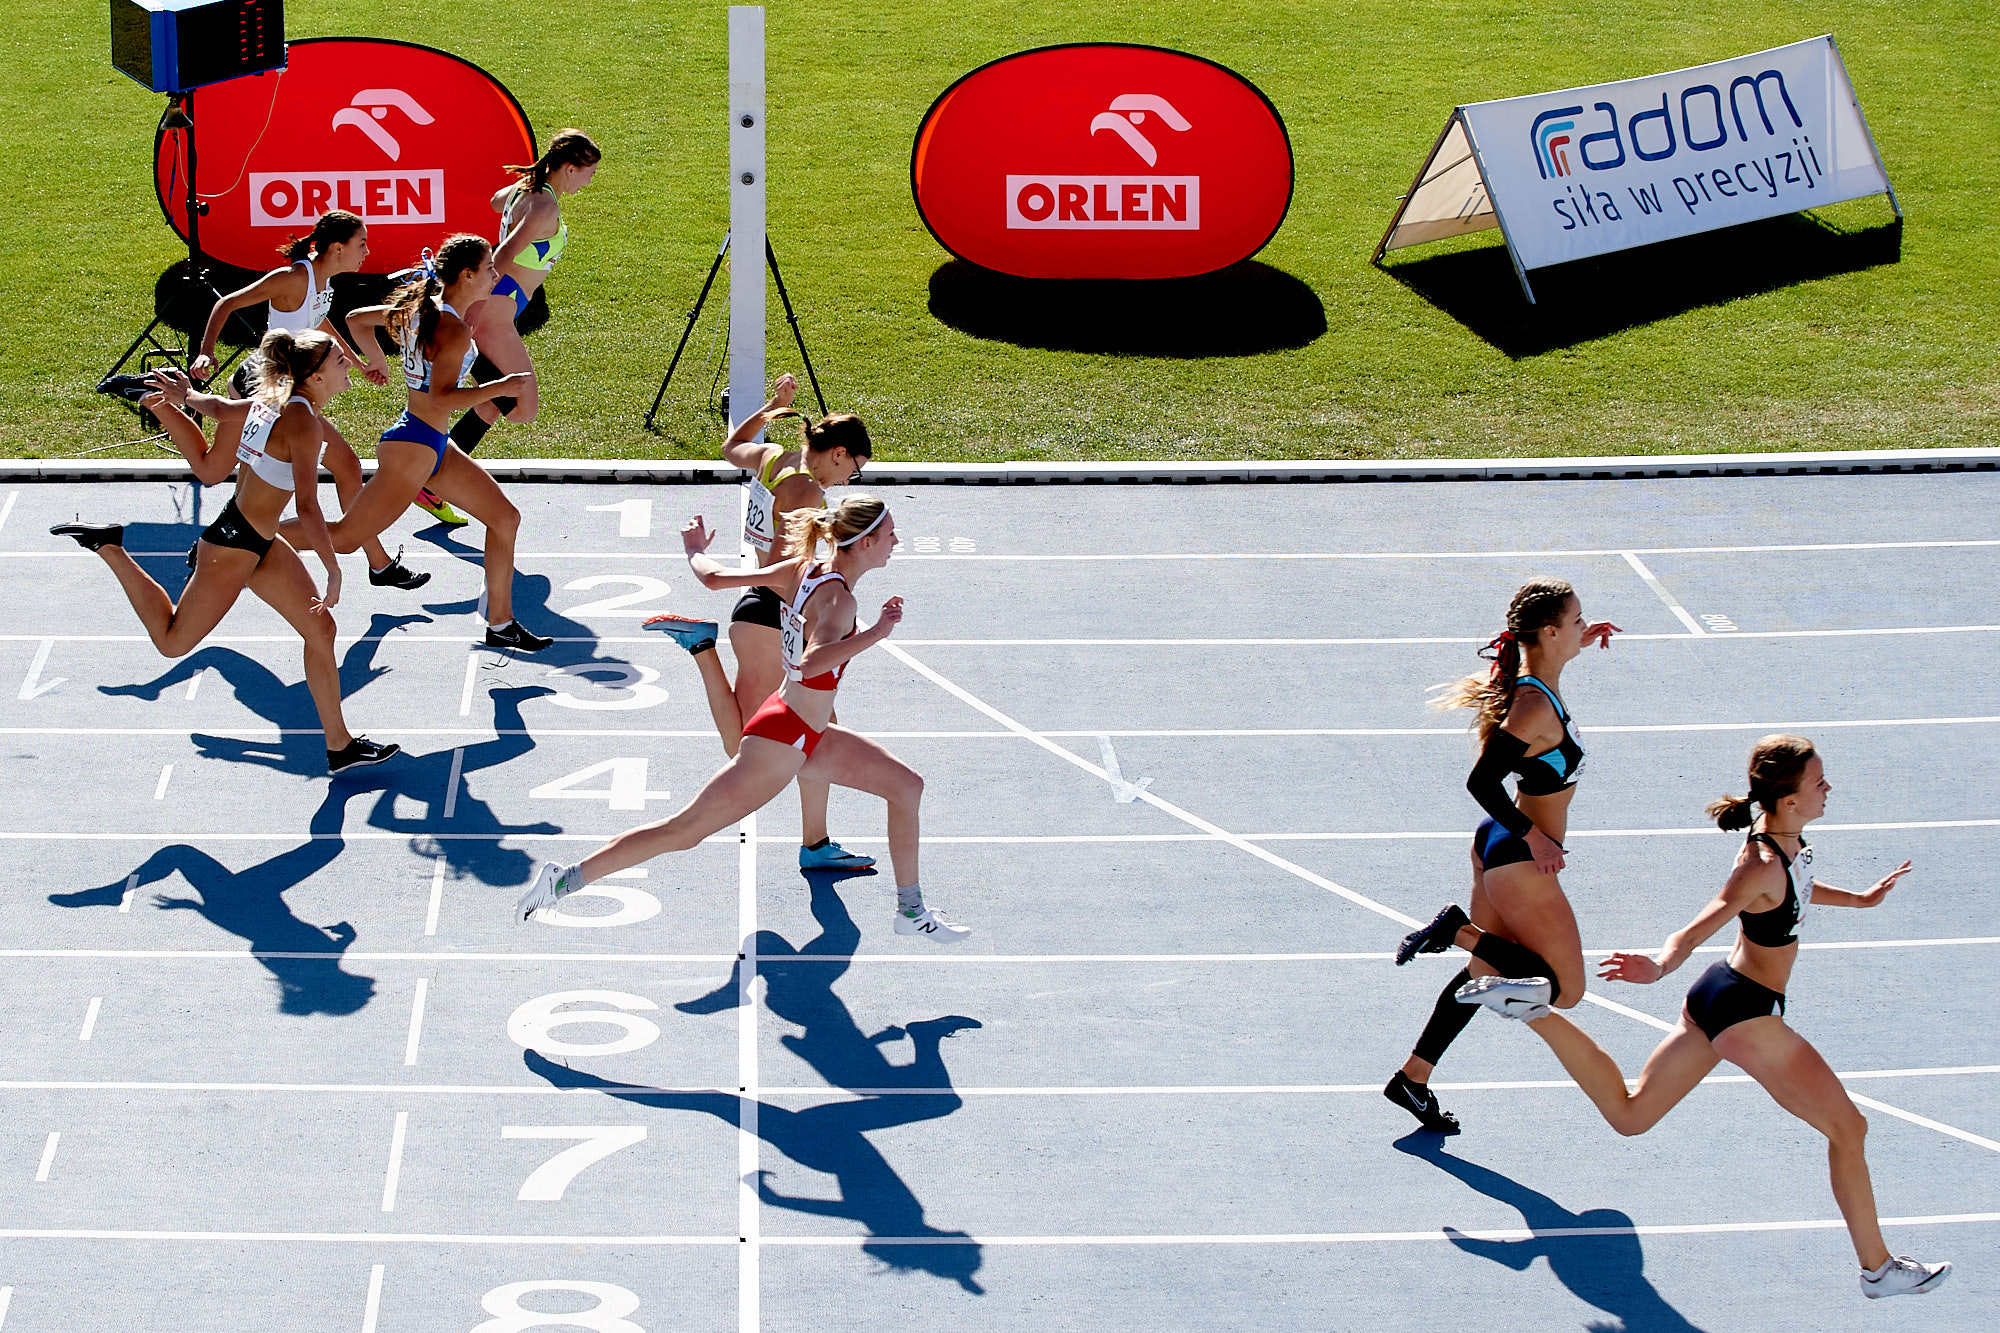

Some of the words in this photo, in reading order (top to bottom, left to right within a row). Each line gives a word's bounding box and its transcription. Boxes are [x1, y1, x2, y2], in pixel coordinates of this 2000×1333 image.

[260, 178, 432, 219] ORLEN
[1017, 183, 1187, 222] ORLEN
[1553, 183, 1623, 230] siła
[1627, 182, 1663, 216] w
[1672, 135, 1823, 216] precyzji
[243, 420, 260, 442] 49
[585, 498, 653, 538] 1
[558, 574, 673, 618] 2
[1700, 614, 1739, 631] 800
[543, 662, 670, 711] 3
[528, 757, 672, 811] 4
[533, 867, 663, 929] 5
[507, 989, 661, 1060] 6
[501, 1124, 649, 1202] 7
[469, 1279, 648, 1333] 8
